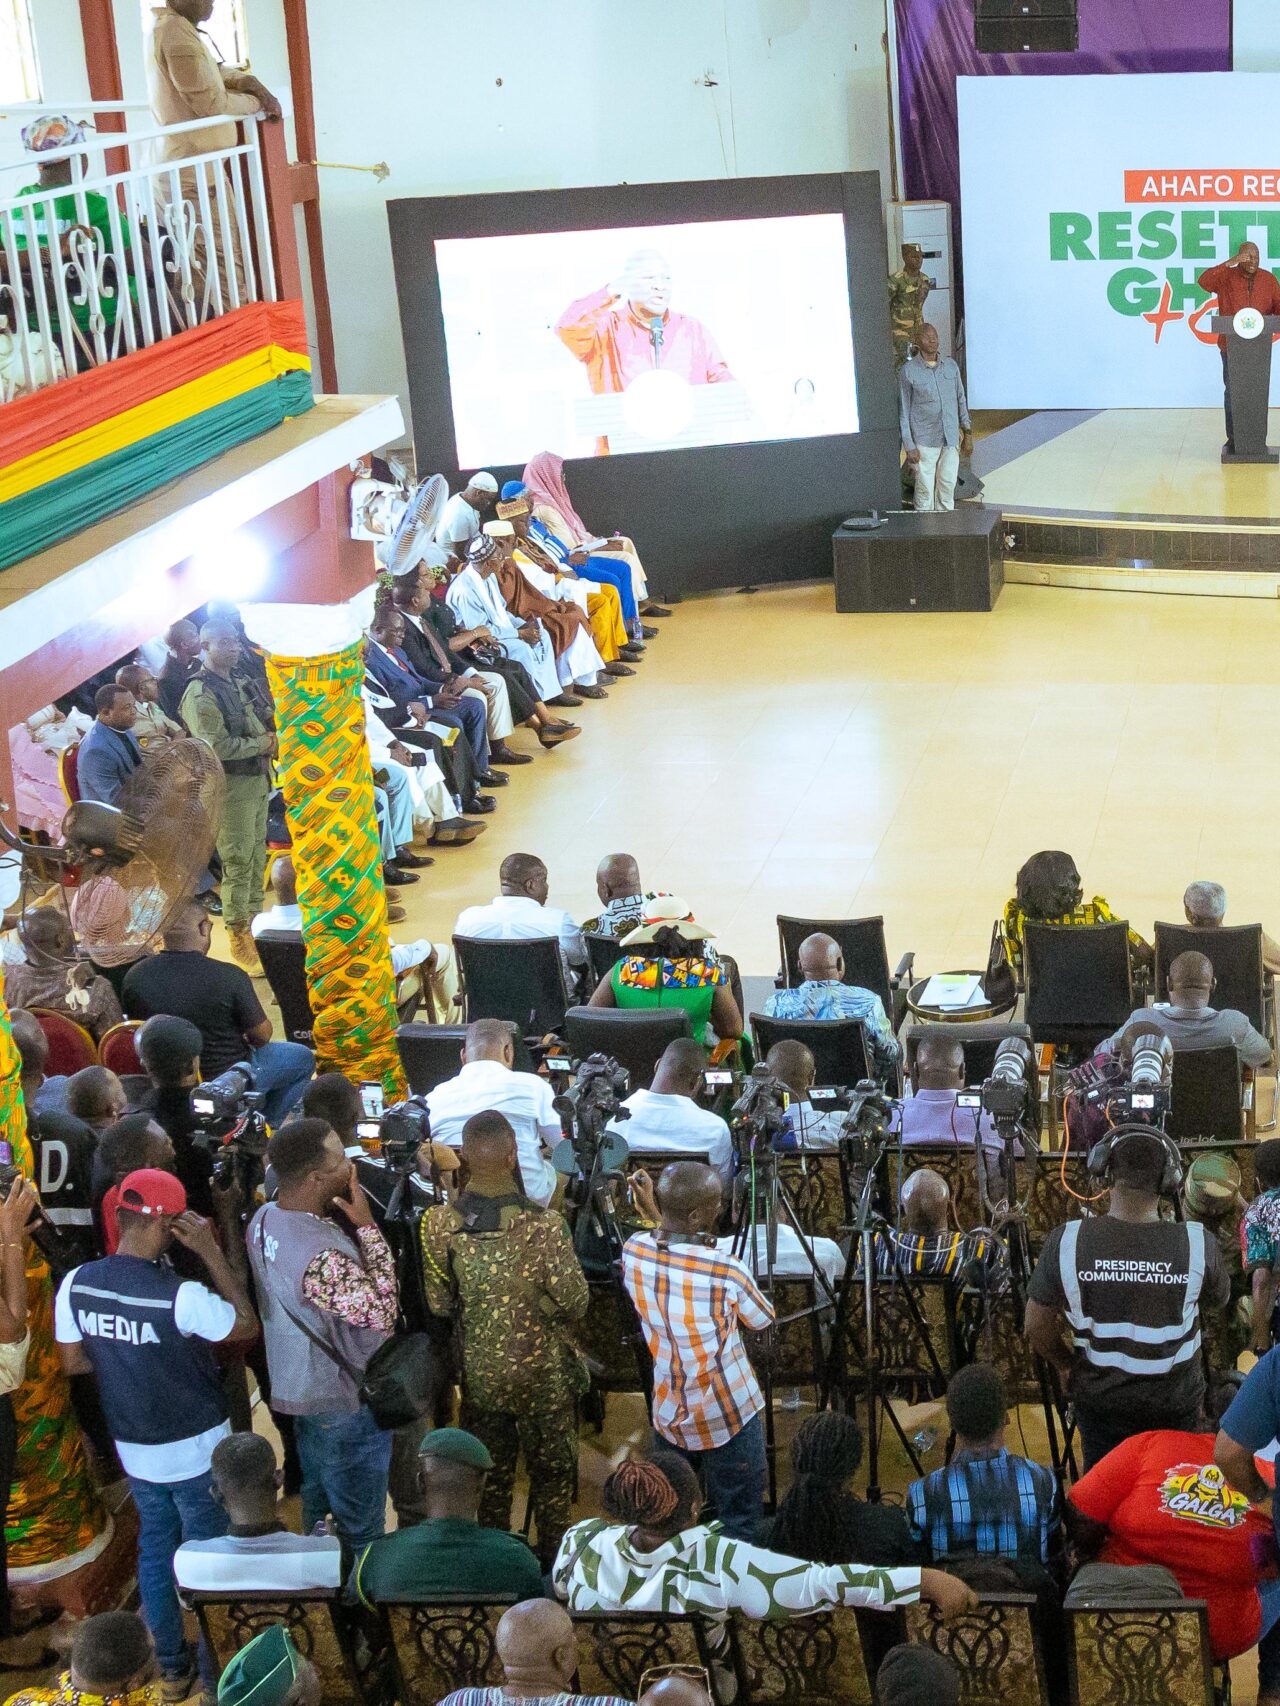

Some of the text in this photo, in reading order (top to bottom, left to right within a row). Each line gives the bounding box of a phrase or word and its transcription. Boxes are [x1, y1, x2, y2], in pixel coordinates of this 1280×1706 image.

[1141, 175, 1234, 197] AHAFO
[1078, 1270, 1189, 1284] COMMUNICATIONS
[1094, 1259, 1172, 1273] PRESIDENCY
[78, 1309, 161, 1346] MEDIA
[1168, 1492, 1236, 1525] GALGA
